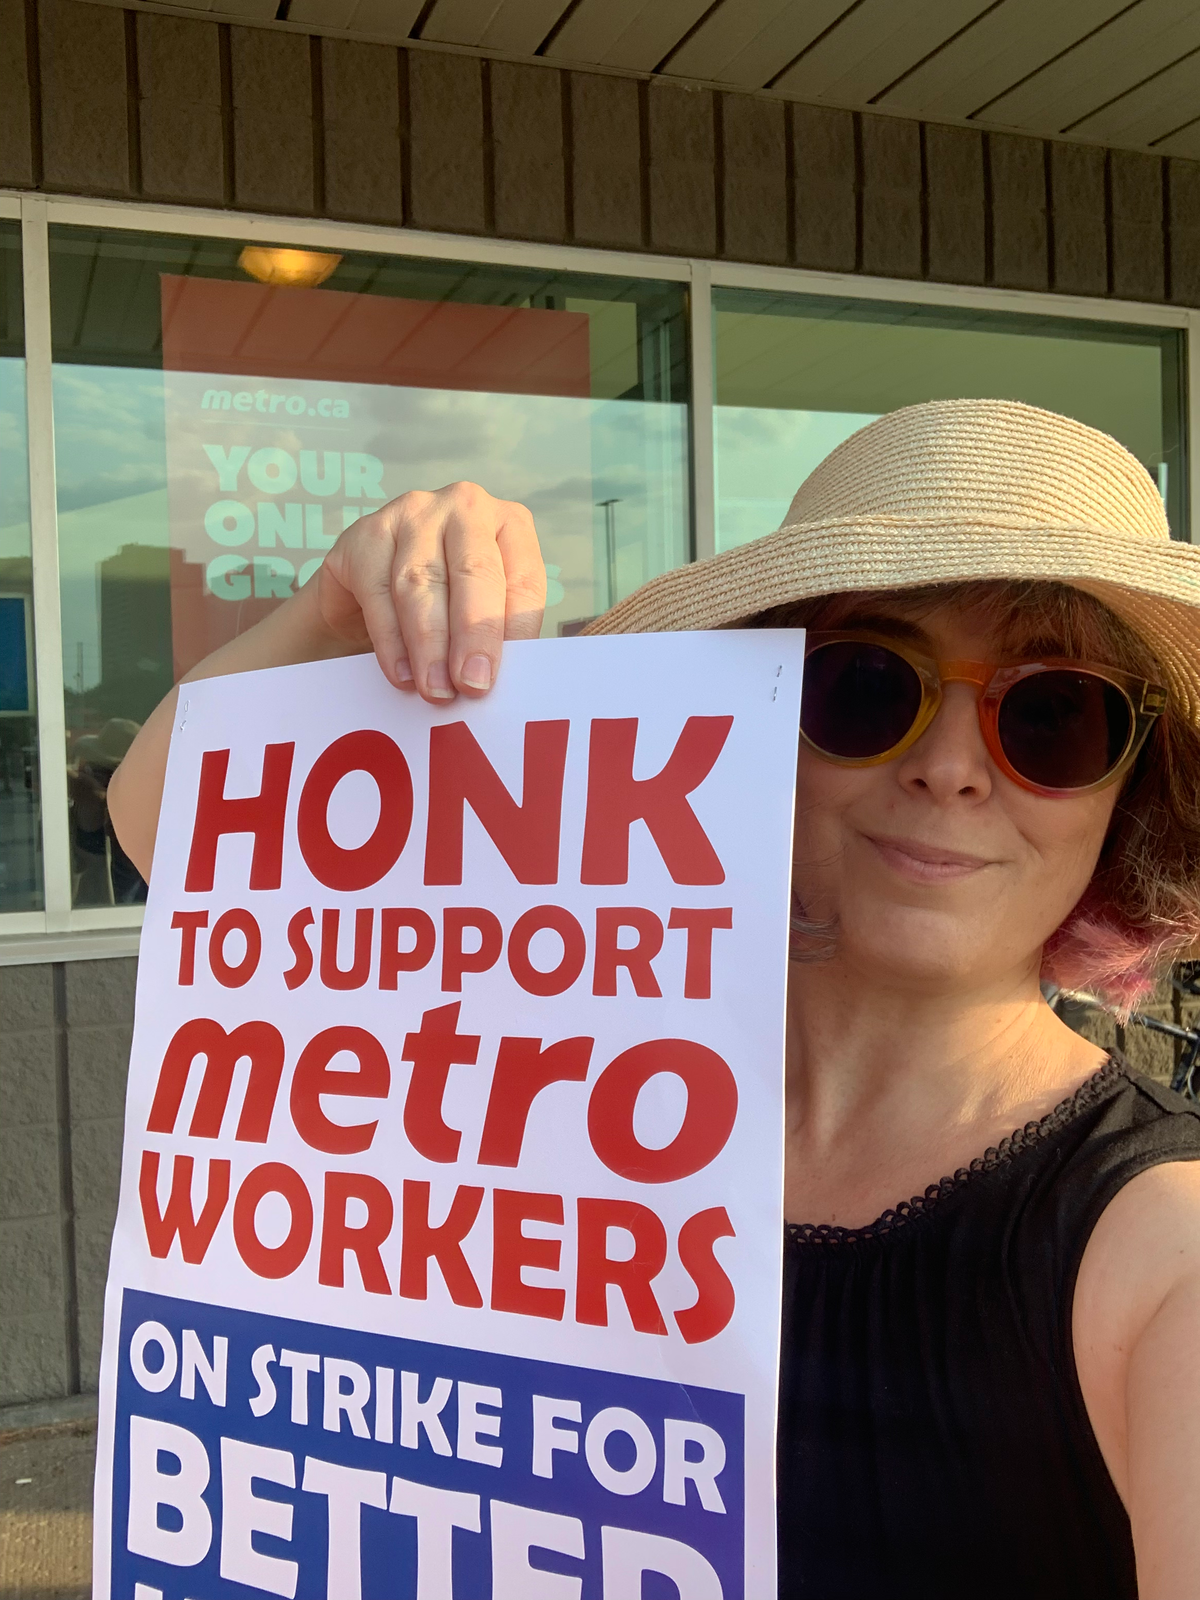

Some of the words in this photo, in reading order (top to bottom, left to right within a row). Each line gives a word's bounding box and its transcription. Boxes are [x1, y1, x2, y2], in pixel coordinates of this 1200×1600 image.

[201, 388, 351, 420] metro.ca
[202, 444, 387, 499] YOUR
[185, 716, 734, 892] HONK
[171, 908, 262, 988] TO
[283, 905, 732, 999] SUPPORT
[147, 1001, 738, 1184] metro
[138, 1150, 736, 1345] WORKERS
[129, 1320, 229, 1408] ON
[248, 1343, 504, 1469] STRIKE
[532, 1394, 727, 1515] FOR
